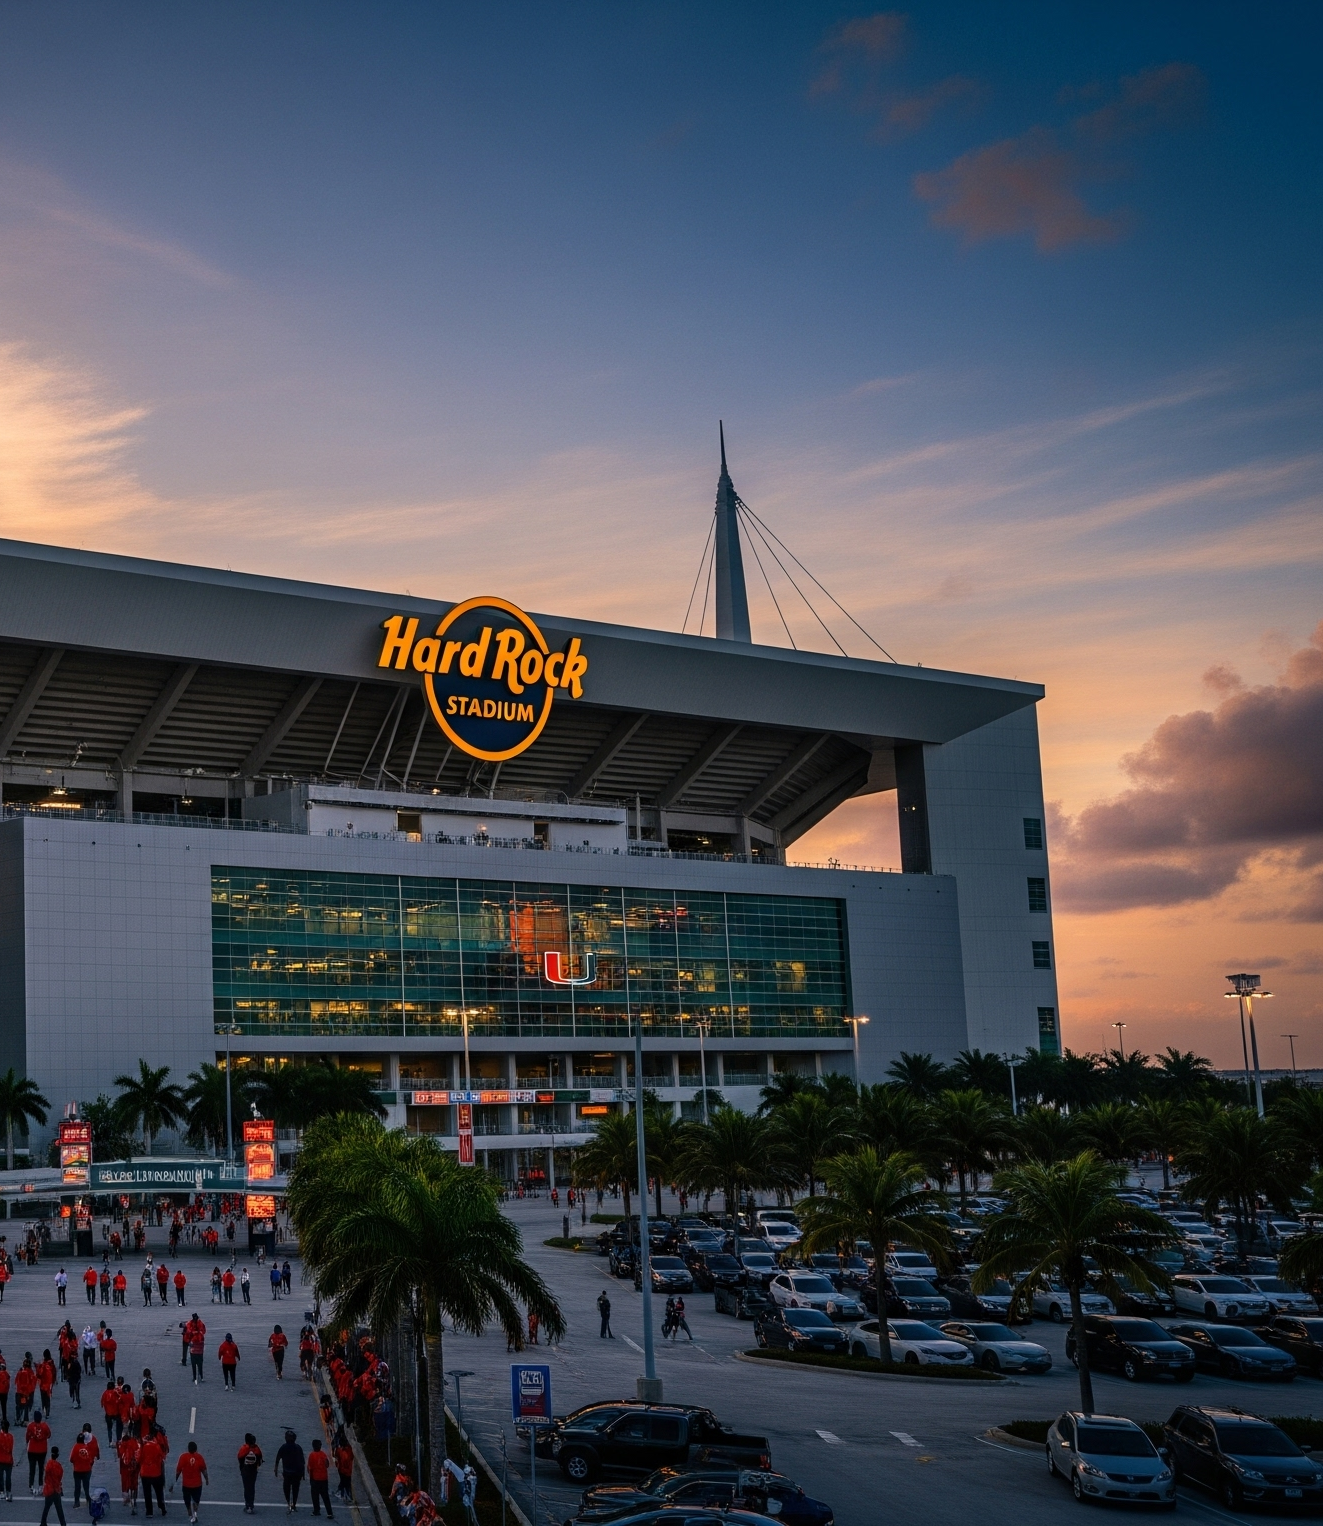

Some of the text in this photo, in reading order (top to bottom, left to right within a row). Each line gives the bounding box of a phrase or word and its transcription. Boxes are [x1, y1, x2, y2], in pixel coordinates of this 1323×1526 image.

[378, 615, 588, 699] Hard Rock
[446, 695, 534, 723] STADIUM
[544, 951, 597, 985] U
